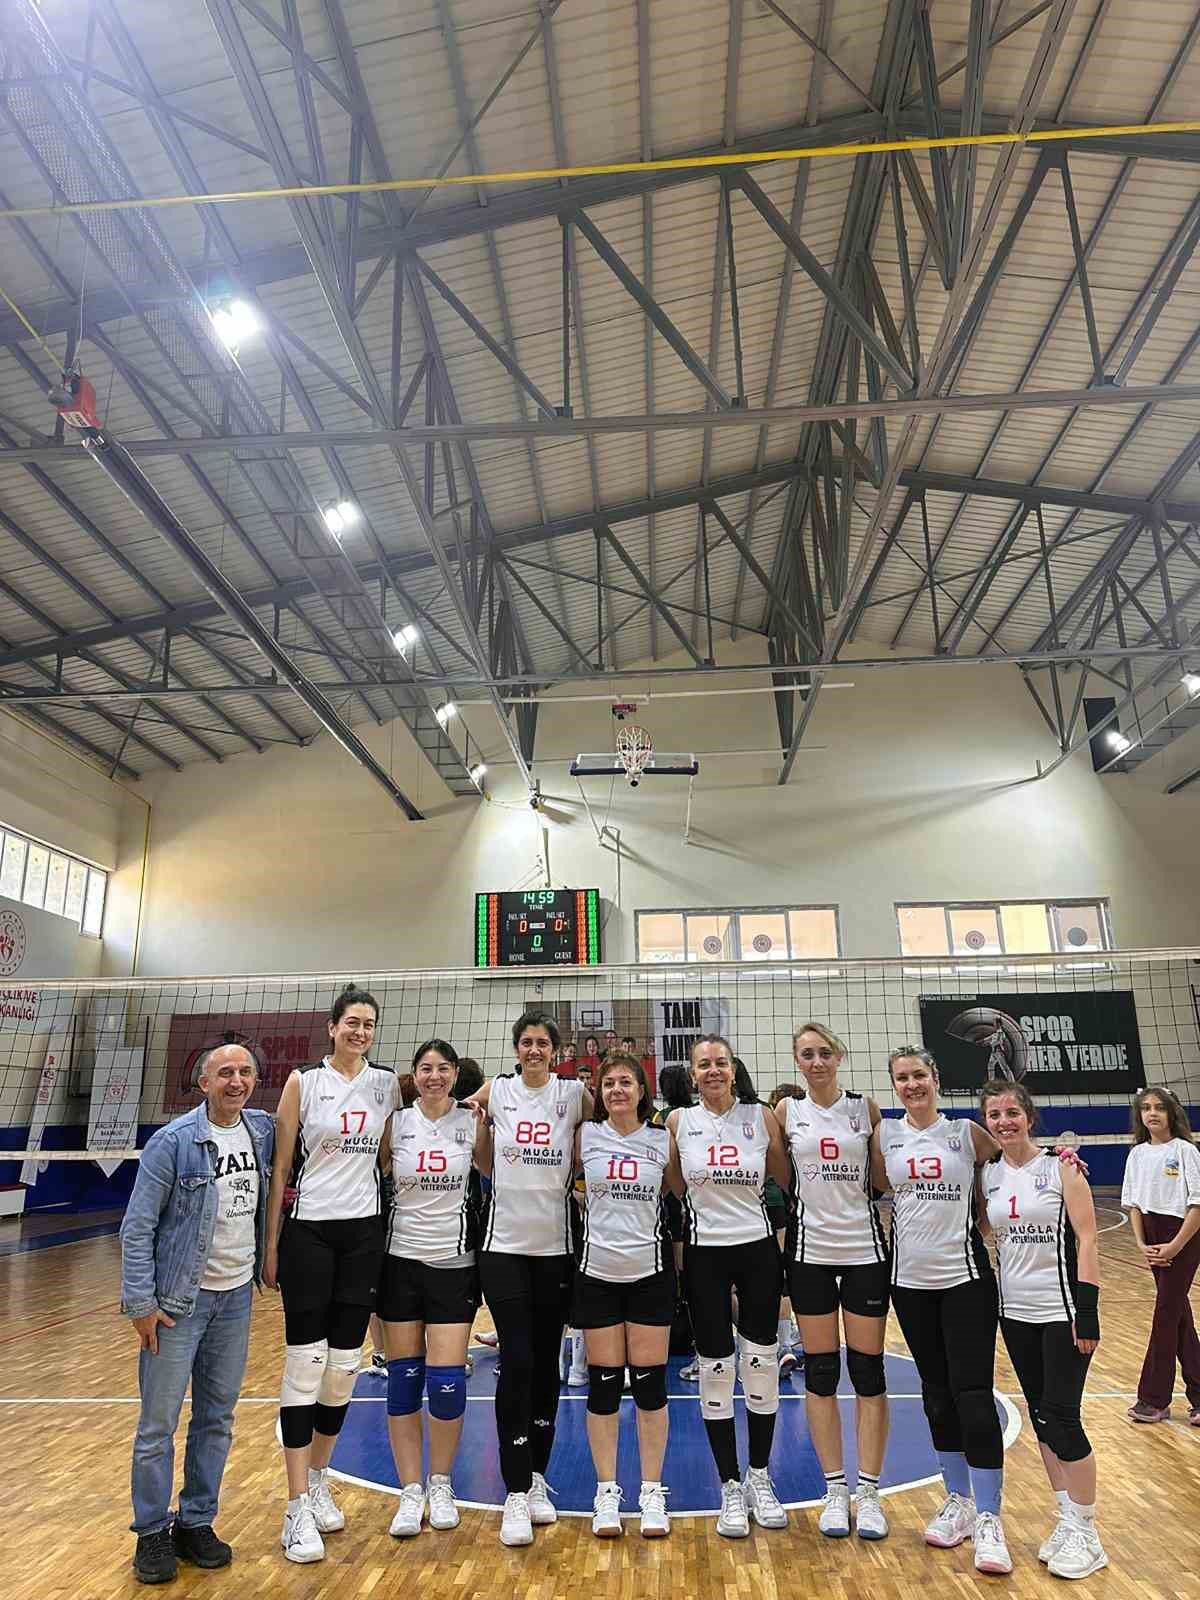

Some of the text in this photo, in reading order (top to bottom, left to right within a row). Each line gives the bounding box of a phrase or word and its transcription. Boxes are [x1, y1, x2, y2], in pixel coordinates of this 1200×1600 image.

[1020, 1015, 1076, 1042] SPOR
[1064, 1044, 1129, 1071] YERDE
[340, 1111, 367, 1134] 17
[516, 1121, 551, 1145] 82
[523, 1146, 563, 1157] MUĞLA
[706, 1145, 739, 1166] 12
[820, 1137, 839, 1160] 6
[215, 1151, 259, 1180] YAL
[416, 1150, 447, 1172] 15
[606, 1159, 637, 1180] 10
[822, 1162, 860, 1173] MUĞLA
[906, 1157, 942, 1179] 13
[916, 1181, 961, 1192] MUĞLA
[1008, 1196, 1020, 1219] 1
[1009, 1223, 1053, 1234] MUĞLA
